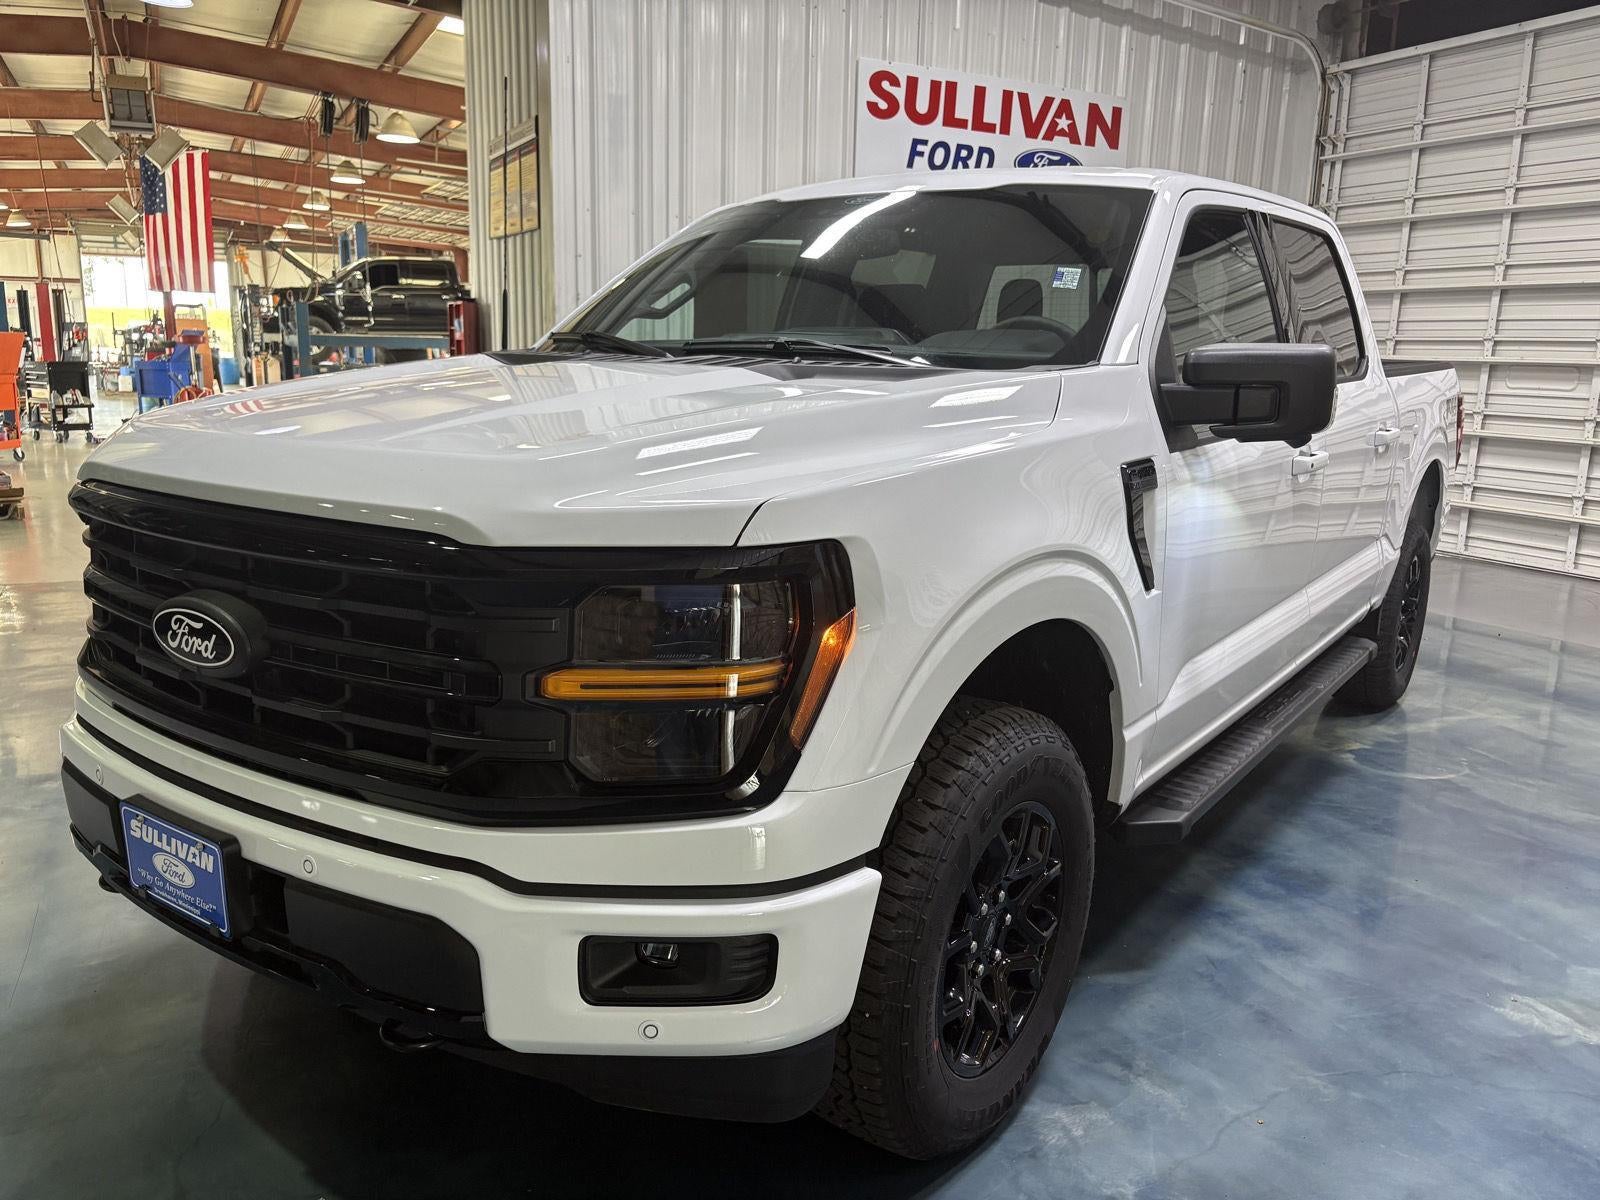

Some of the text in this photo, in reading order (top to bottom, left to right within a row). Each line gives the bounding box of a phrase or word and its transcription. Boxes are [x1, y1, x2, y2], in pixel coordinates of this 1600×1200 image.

[866, 70, 1122, 150] SULLIVAN
[906, 137, 995, 171] FORD
[167, 614, 216, 660] Ford
[130, 817, 214, 873] SULLIVAN
[154, 876, 164, 887] Go
[165, 882, 195, 904] Anywhere
[161, 858, 186, 884] Ford
